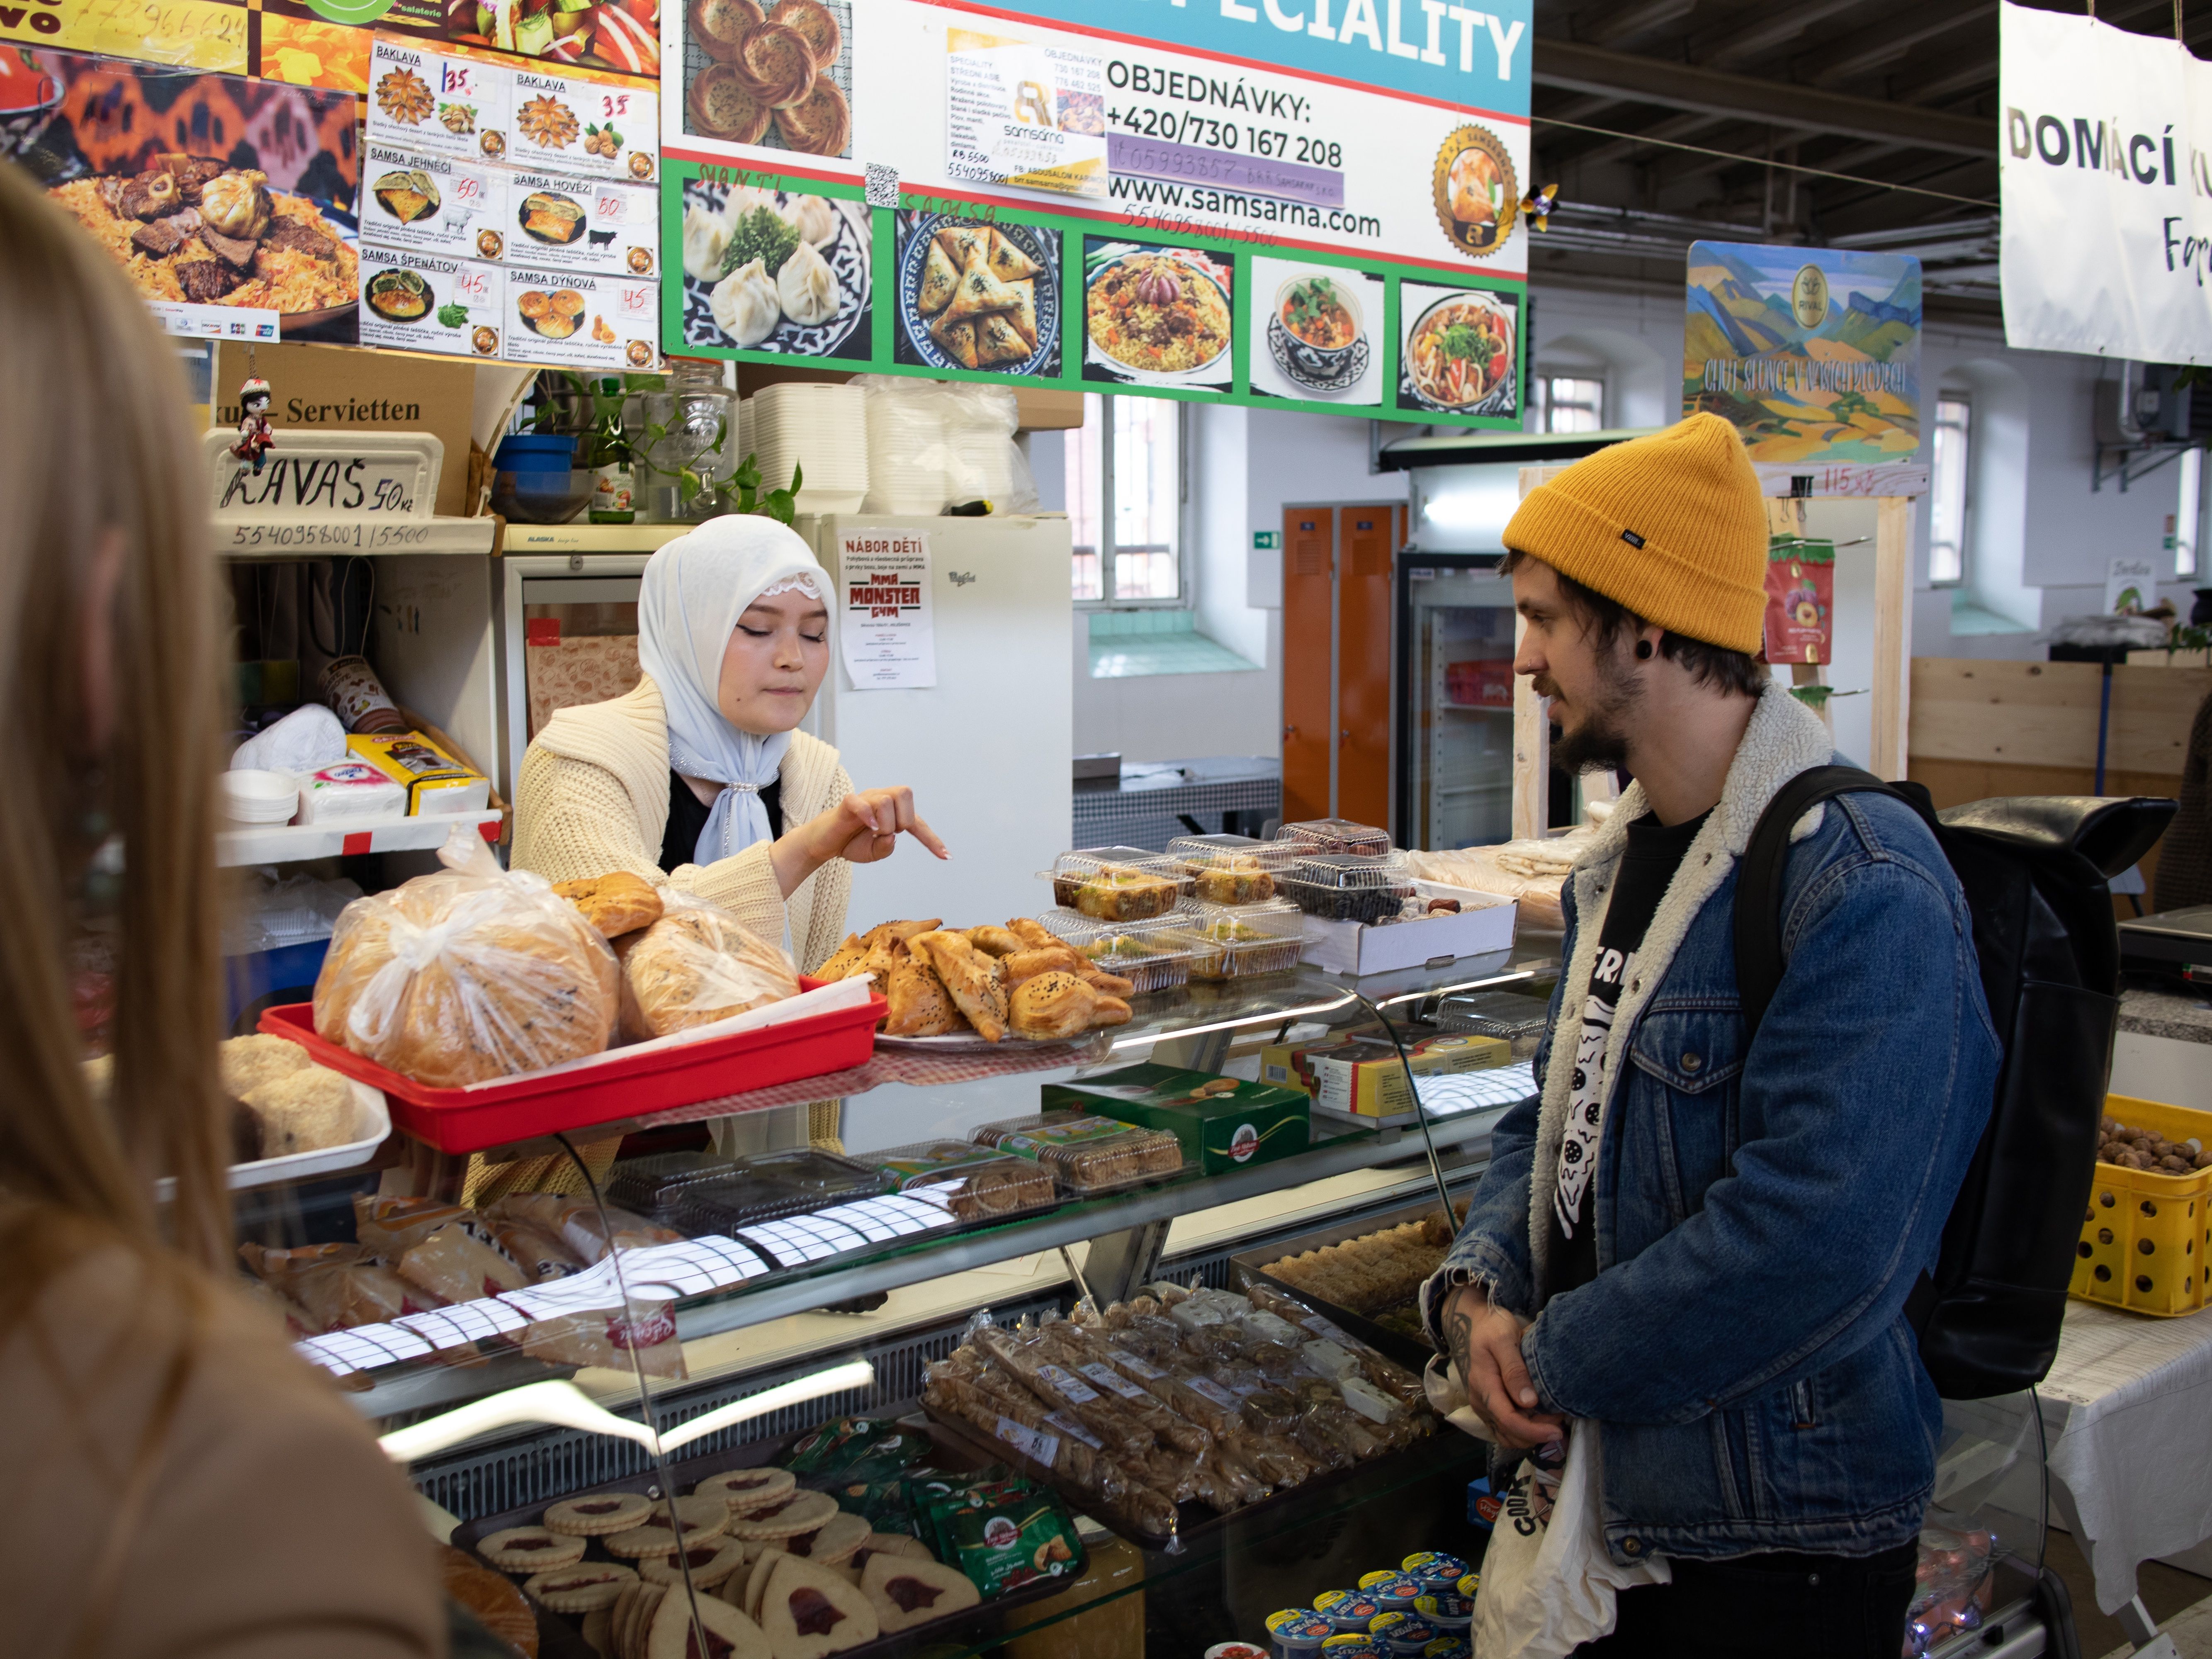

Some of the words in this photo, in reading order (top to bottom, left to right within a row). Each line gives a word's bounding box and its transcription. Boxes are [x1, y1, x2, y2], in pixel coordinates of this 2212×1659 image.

[377, 46, 421, 66] BAKLAVA
[517, 74, 566, 92] BAKLAVA
[1107, 61, 1310, 123] OBJEDNÁVKY:
[1107, 107, 1237, 149] +420/730
[1247, 126, 1287, 158] 167
[1296, 136, 1342, 167] 208
[2007, 106, 2176, 185] DOMÁCÍ
[370, 148, 405, 164] SAMSA
[513, 174, 550, 188] SAMSA
[554, 179, 592, 195] HOVĚZÍ
[1108, 177, 1381, 237] www.samsarna.com
[362, 249, 398, 264] SAMSA
[401, 253, 459, 272] ŠPENÁTOV
[461, 274, 485, 294] 45
[510, 271, 550, 285] SAMSA
[551, 274, 597, 290] DÝŇOVÁ
[1798, 300, 1823, 311] RIVAL
[1743, 359, 1788, 392] SLUNCE
[287, 398, 421, 424] Servietten
[846, 536, 890, 553] NÁBOR
[893, 536, 922, 553] DĚTÍ
[871, 573, 898, 585] MMA
[850, 587, 920, 605] MONSTER
[871, 606, 899, 618] GYM
